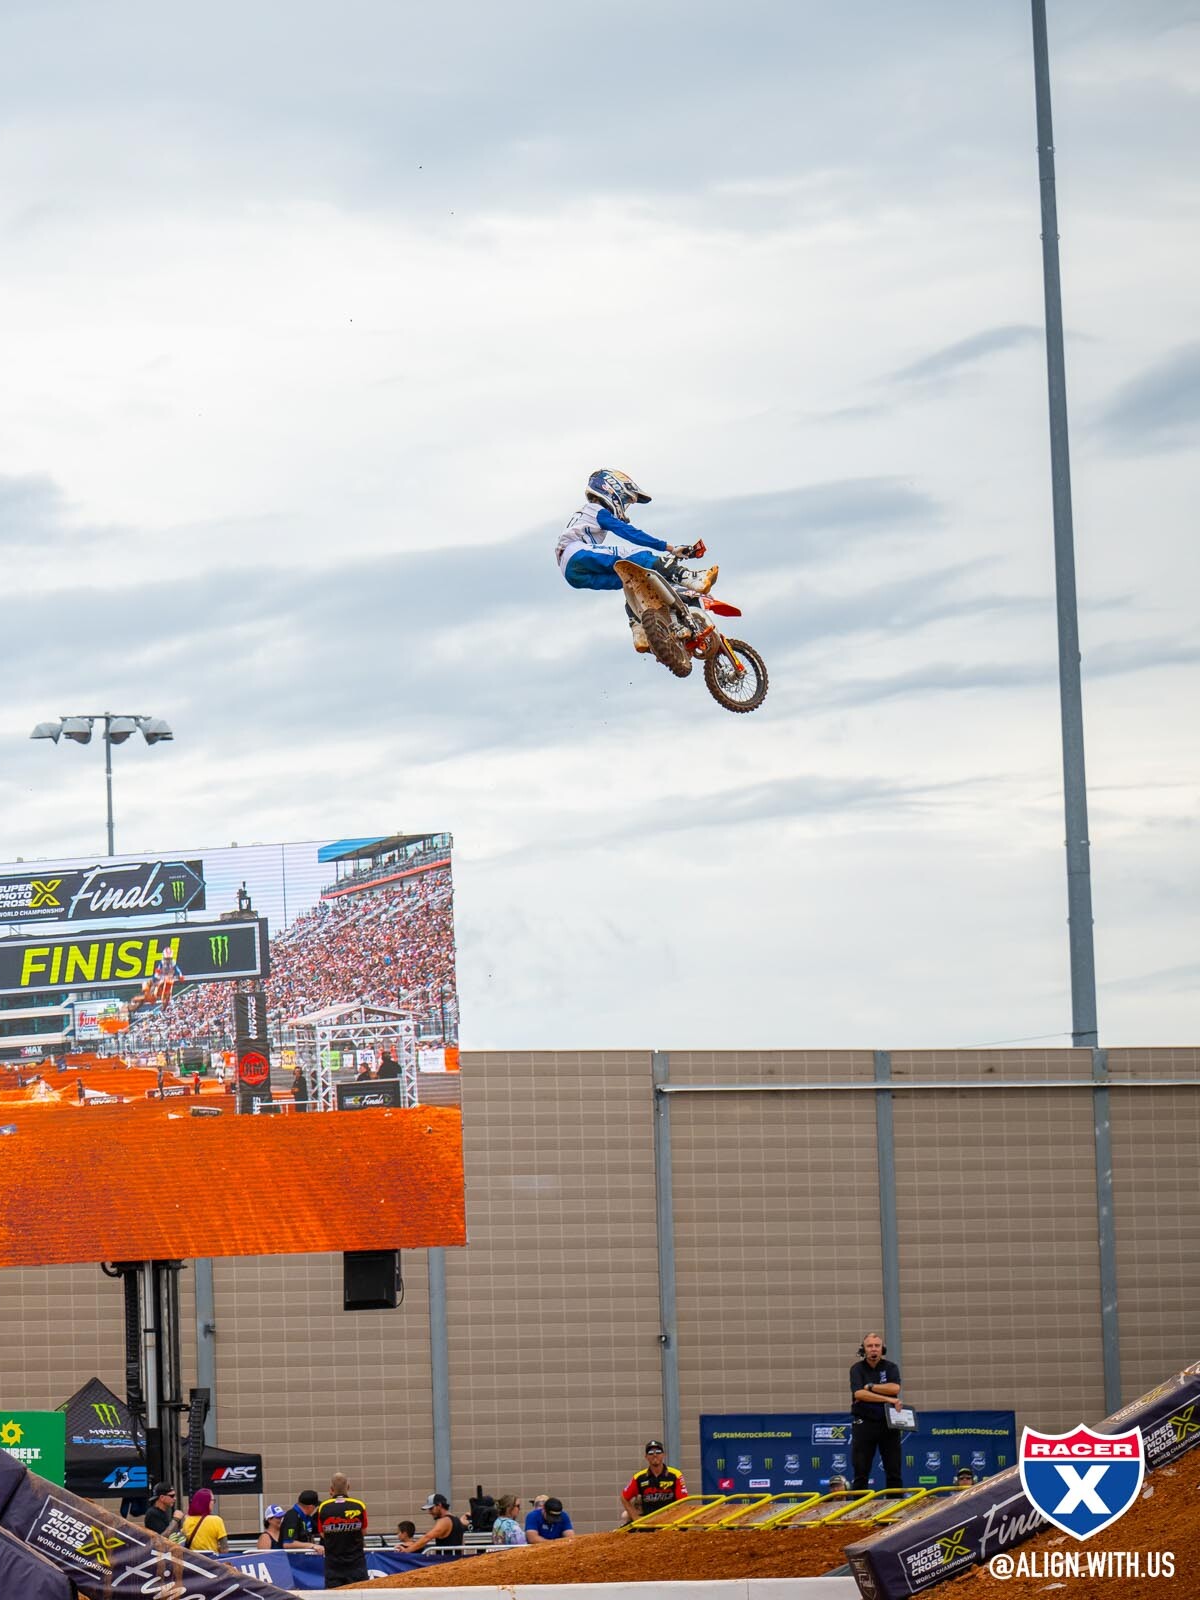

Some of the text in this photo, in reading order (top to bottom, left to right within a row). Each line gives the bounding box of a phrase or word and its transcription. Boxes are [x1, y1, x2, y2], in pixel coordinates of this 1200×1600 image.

[68, 862, 165, 919] Finals
[20, 907, 65, 916] CHAMPIONSHIP
[20, 936, 181, 986] FINISH
[1143, 1422, 1173, 1446] SUPER
[1147, 1430, 1174, 1451] MOTO
[1148, 1434, 1178, 1458] CROSS
[47, 1517, 87, 1541] MOTO
[48, 1508, 93, 1535] SUPER
[40, 1524, 85, 1549] CROSS
[36, 1535, 113, 1576] WORLD CHAMPIONSHIP
[907, 1543, 941, 1565] SUPER
[911, 1550, 942, 1570] MOTO
[912, 1556, 945, 1577] CROSS
[915, 1552, 977, 1585] WORLD CHAMPIONSHIP
